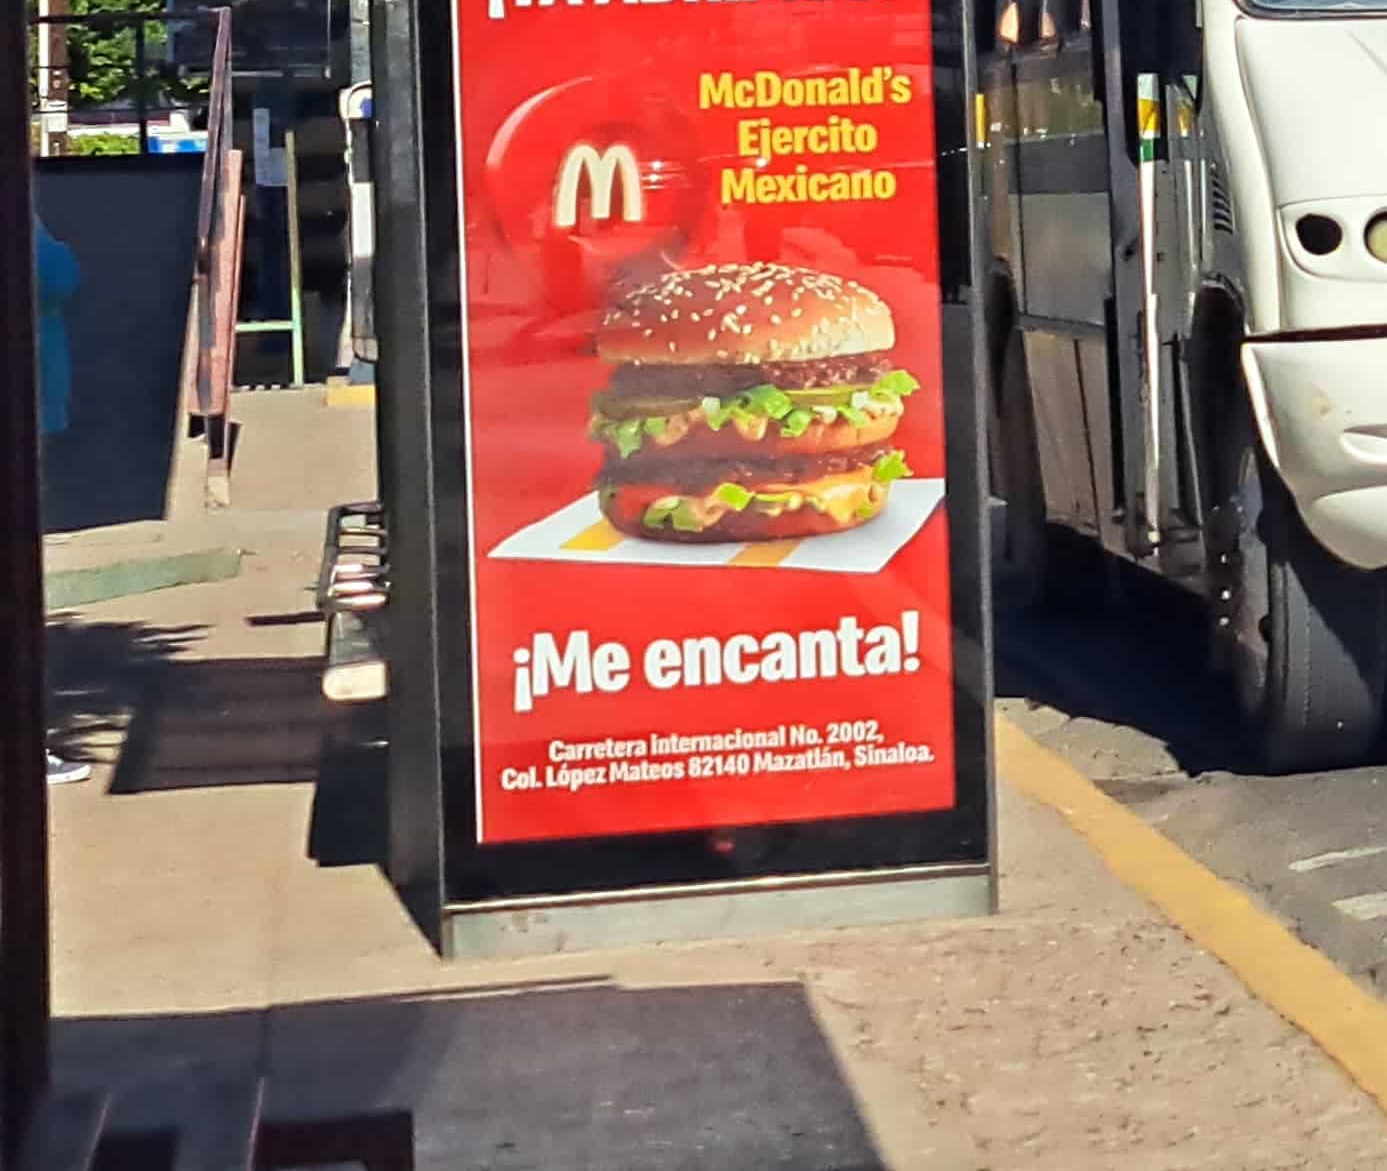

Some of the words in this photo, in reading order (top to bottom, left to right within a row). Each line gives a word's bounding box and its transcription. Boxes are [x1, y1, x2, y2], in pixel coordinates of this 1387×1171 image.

[738, 115, 878, 163] Ejercito
[721, 164, 897, 205] Mexicano
[512, 629, 632, 714] ¡Me
[642, 610, 921, 690] encanta!
[548, 737, 647, 763] Carretera
[650, 726, 787, 757] Internacional
[790, 725, 824, 746] No.
[826, 720, 885, 745] 2002,
[501, 766, 543, 791] Col.
[546, 762, 607, 793] López
[608, 759, 685, 784] Mateos
[688, 754, 750, 778] 82140
[753, 747, 852, 774] Mazatlán,
[854, 740, 937, 767] Sinaloa.
